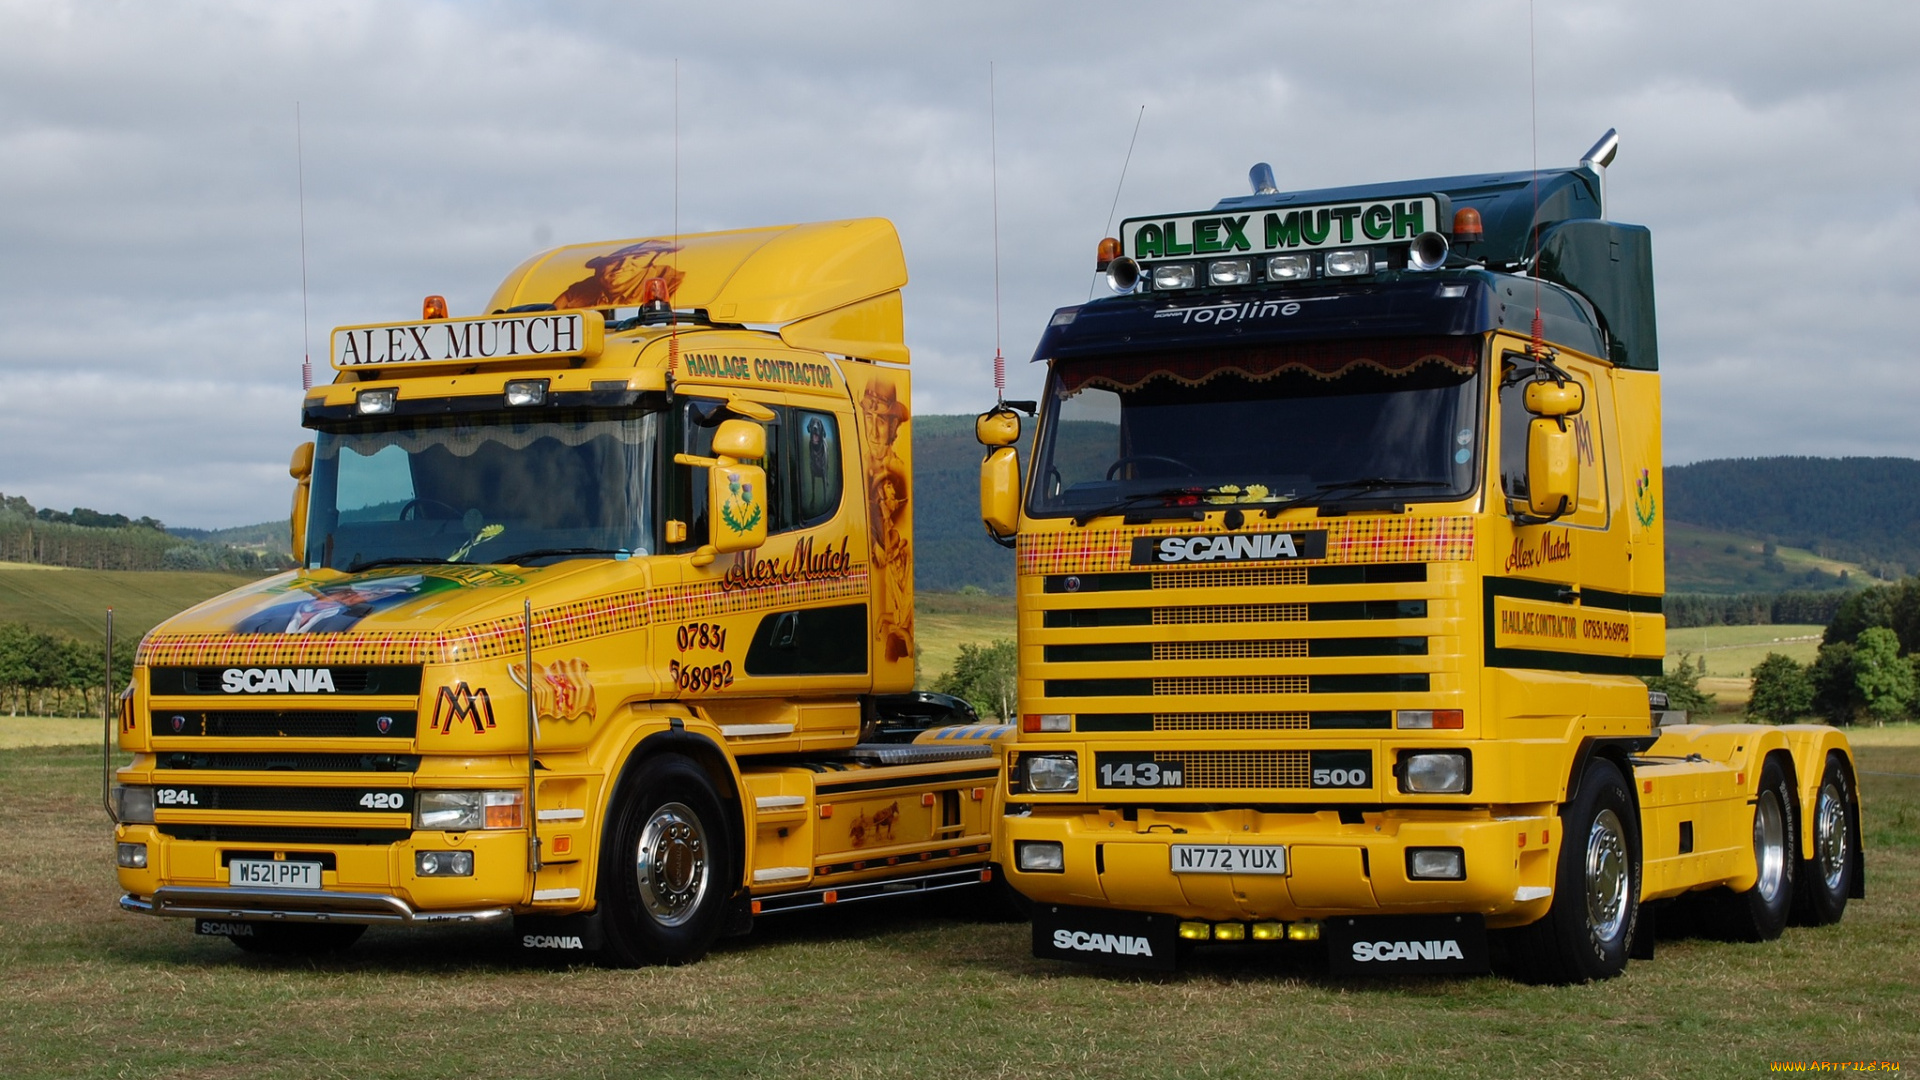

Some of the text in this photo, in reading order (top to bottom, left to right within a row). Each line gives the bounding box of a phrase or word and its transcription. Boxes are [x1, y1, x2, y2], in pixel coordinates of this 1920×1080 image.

[1136, 200, 1425, 259] ALEX MUTCH
[1182, 302, 1301, 325] Topline
[339, 315, 579, 366] ALEX MUTCH
[684, 353, 834, 388] HAULAGE CONTRACTOR
[1158, 533, 1298, 562] SCANIA
[1505, 528, 1571, 574] Alex Mutch
[722, 535, 851, 591] Alex Mutch
[677, 622, 727, 653] 07831
[1501, 610, 1535, 635] HAULAGE
[1535, 613, 1577, 639] CONTRACTOR
[221, 668, 335, 693] SCANIA
[669, 659, 734, 694] 568952
[1313, 768, 1366, 786] 500
[359, 793, 404, 809] 420
[1180, 848, 1278, 868] N772 YUX
[240, 863, 311, 883] W521 PPT
[201, 921, 254, 936] SCANIA
[523, 935, 583, 949] SCANIA
[1052, 929, 1152, 957] SCANIA
[1352, 939, 1464, 962] SCANIA
